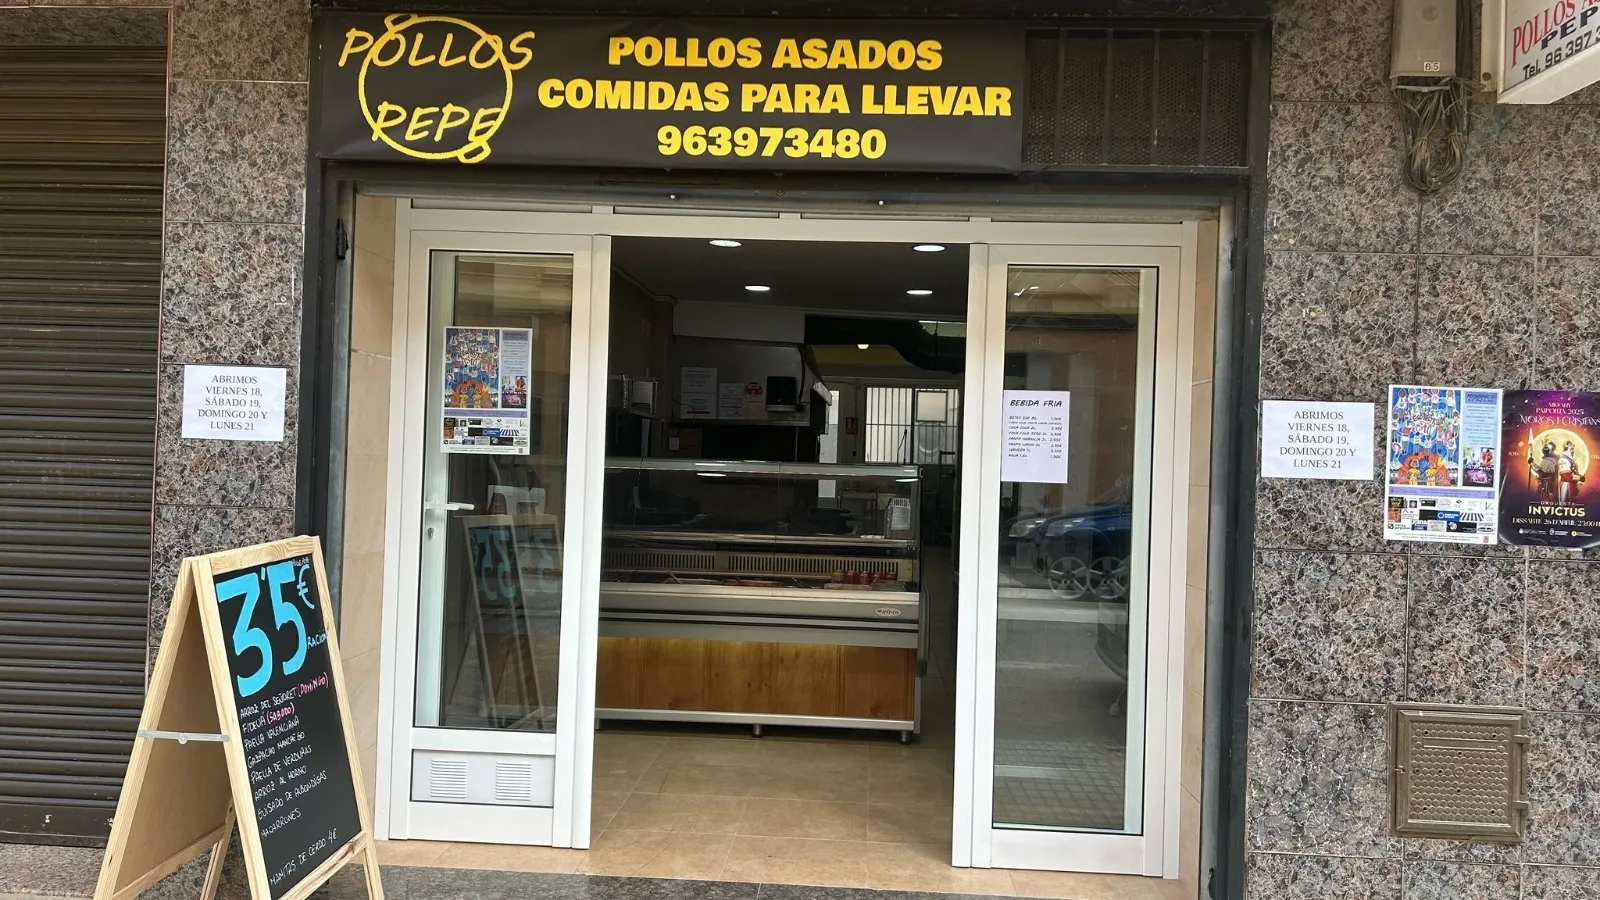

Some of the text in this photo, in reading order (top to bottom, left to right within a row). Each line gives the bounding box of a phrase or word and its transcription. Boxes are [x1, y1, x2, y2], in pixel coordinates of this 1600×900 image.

[1509, 0, 1575, 69] POLLOS
[338, 27, 536, 70] POLLOS
[608, 36, 943, 71] POLLOS ASADOS
[1523, 58, 1540, 80] Tel.
[1544, 47, 1562, 69] 96
[1565, 30, 1593, 59] 397
[1424, 62, 1440, 71] 65
[537, 78, 1012, 117] COMIDAS PARA LLEVAR
[371, 100, 502, 142] PEPE
[657, 124, 887, 160] 963973480
[211, 374, 258, 385] ABRIMOS
[205, 386, 263, 397] VIERNES 18,
[205, 396, 261, 408] SÁBADO 19,
[1010, 399, 1063, 408] BEBIDA FRIA
[198, 409, 268, 420] DOMINGO 20 Y
[1293, 411, 1344, 420] ABRIMOS
[210, 421, 254, 431] LUNES 21
[1288, 422, 1350, 433] VIERNES 18,
[1287, 433, 1350, 445] SÁBADO 19,
[1279, 446, 1356, 457] DOMINGO 20 Y
[1293, 459, 1341, 469] LUNES 21
[1528, 505, 1586, 517] INVICTUS
[240, 703, 260, 720] ARROZ
[260, 698, 272, 710] DEL
[244, 715, 300, 751] PAELLA VALENCIANA
[247, 746, 276, 769] GAZPACHO
[250, 744, 313, 784] PAELLA DE VERDURAS
[254, 765, 307, 802] ARROZ AL HORNO
[284, 791, 293, 801] DE
[260, 807, 302, 840] MACARRONES
[298, 852, 307, 866] DE
[308, 837, 327, 857] CERDO
